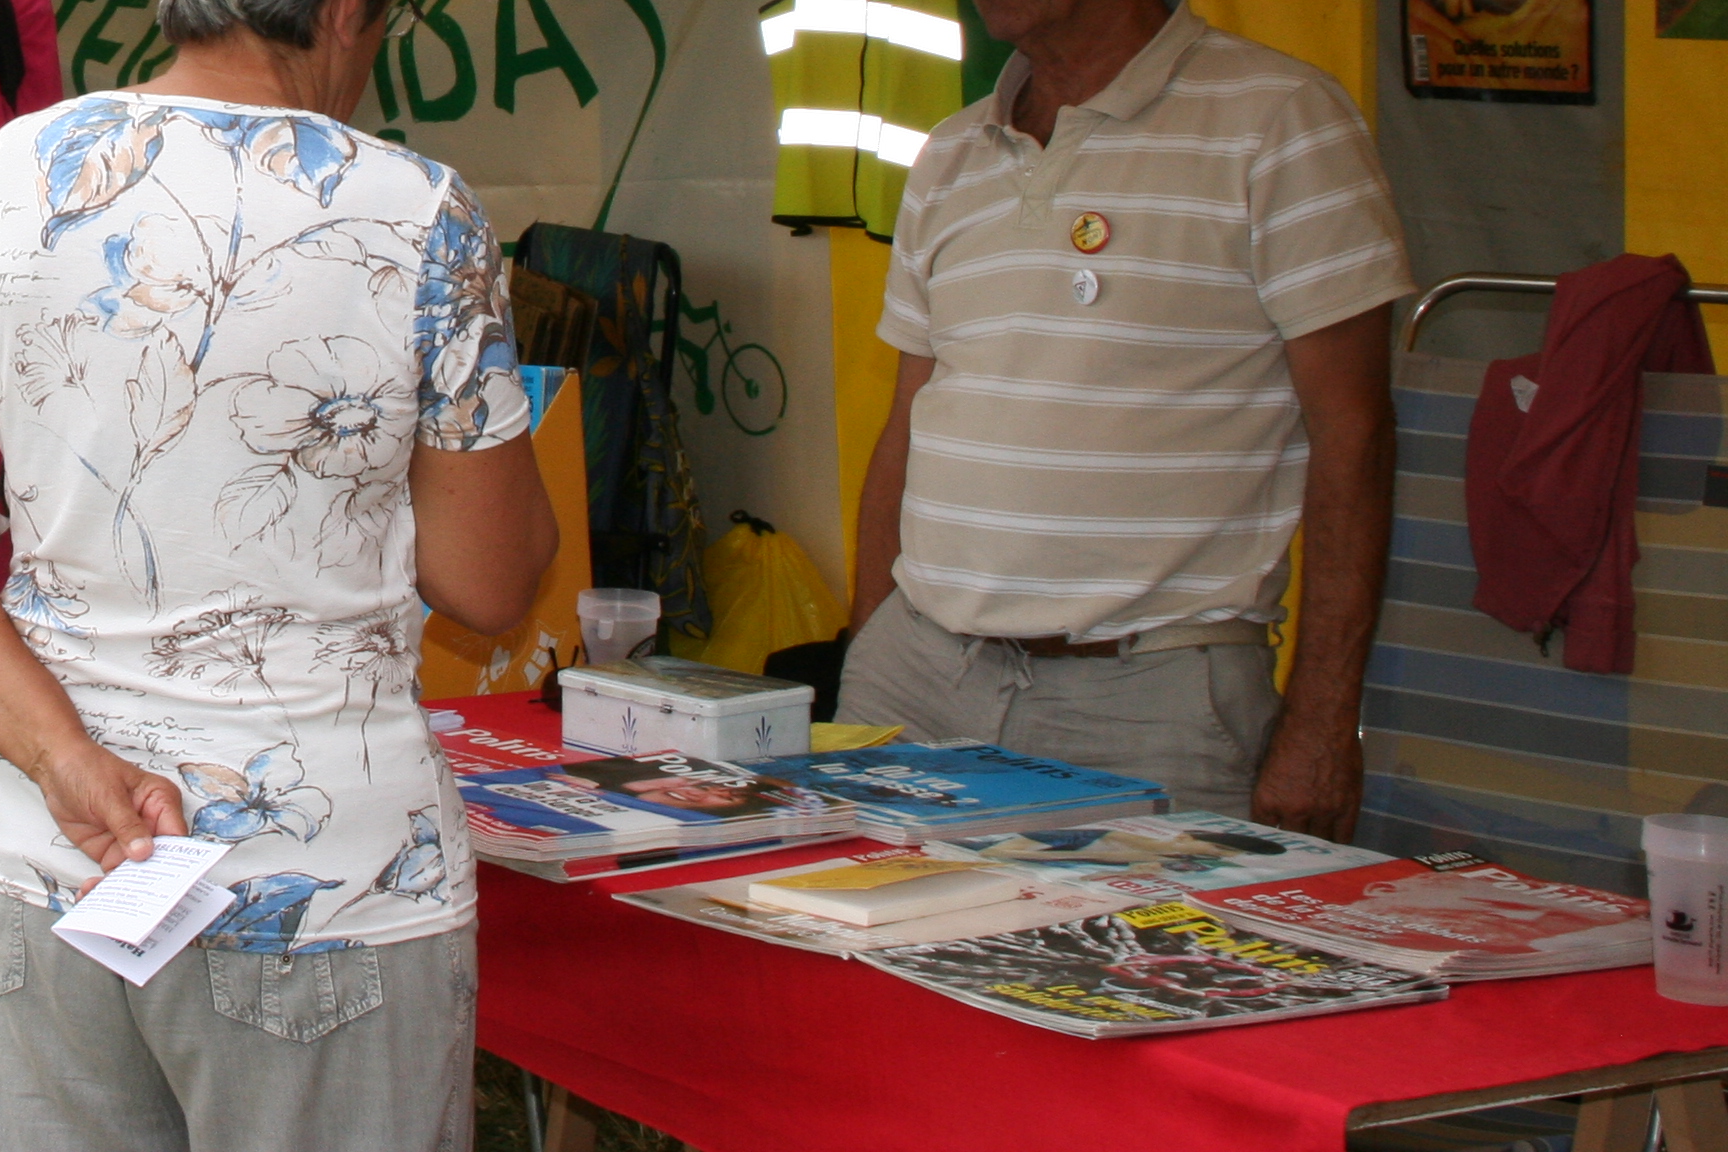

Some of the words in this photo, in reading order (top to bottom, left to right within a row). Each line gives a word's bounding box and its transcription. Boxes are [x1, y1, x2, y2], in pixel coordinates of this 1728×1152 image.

[1454, 39, 1497, 59] Quelles
[1500, 39, 1560, 59] solutions
[1488, 61, 1521, 79] autre
[1523, 62, 1570, 81] monde
[444, 728, 566, 762] Politis
[634, 753, 758, 789] Politis
[951, 745, 1081, 780] Politis
[809, 762, 850, 775] la
[832, 773, 946, 800] presse
[1414, 850, 1473, 866] Politis
[1251, 893, 1286, 906] de
[1278, 889, 1324, 905] Les
[1459, 867, 1630, 915] Politis
[1122, 901, 1187, 920] Politis
[1162, 921, 1330, 974] Politis
